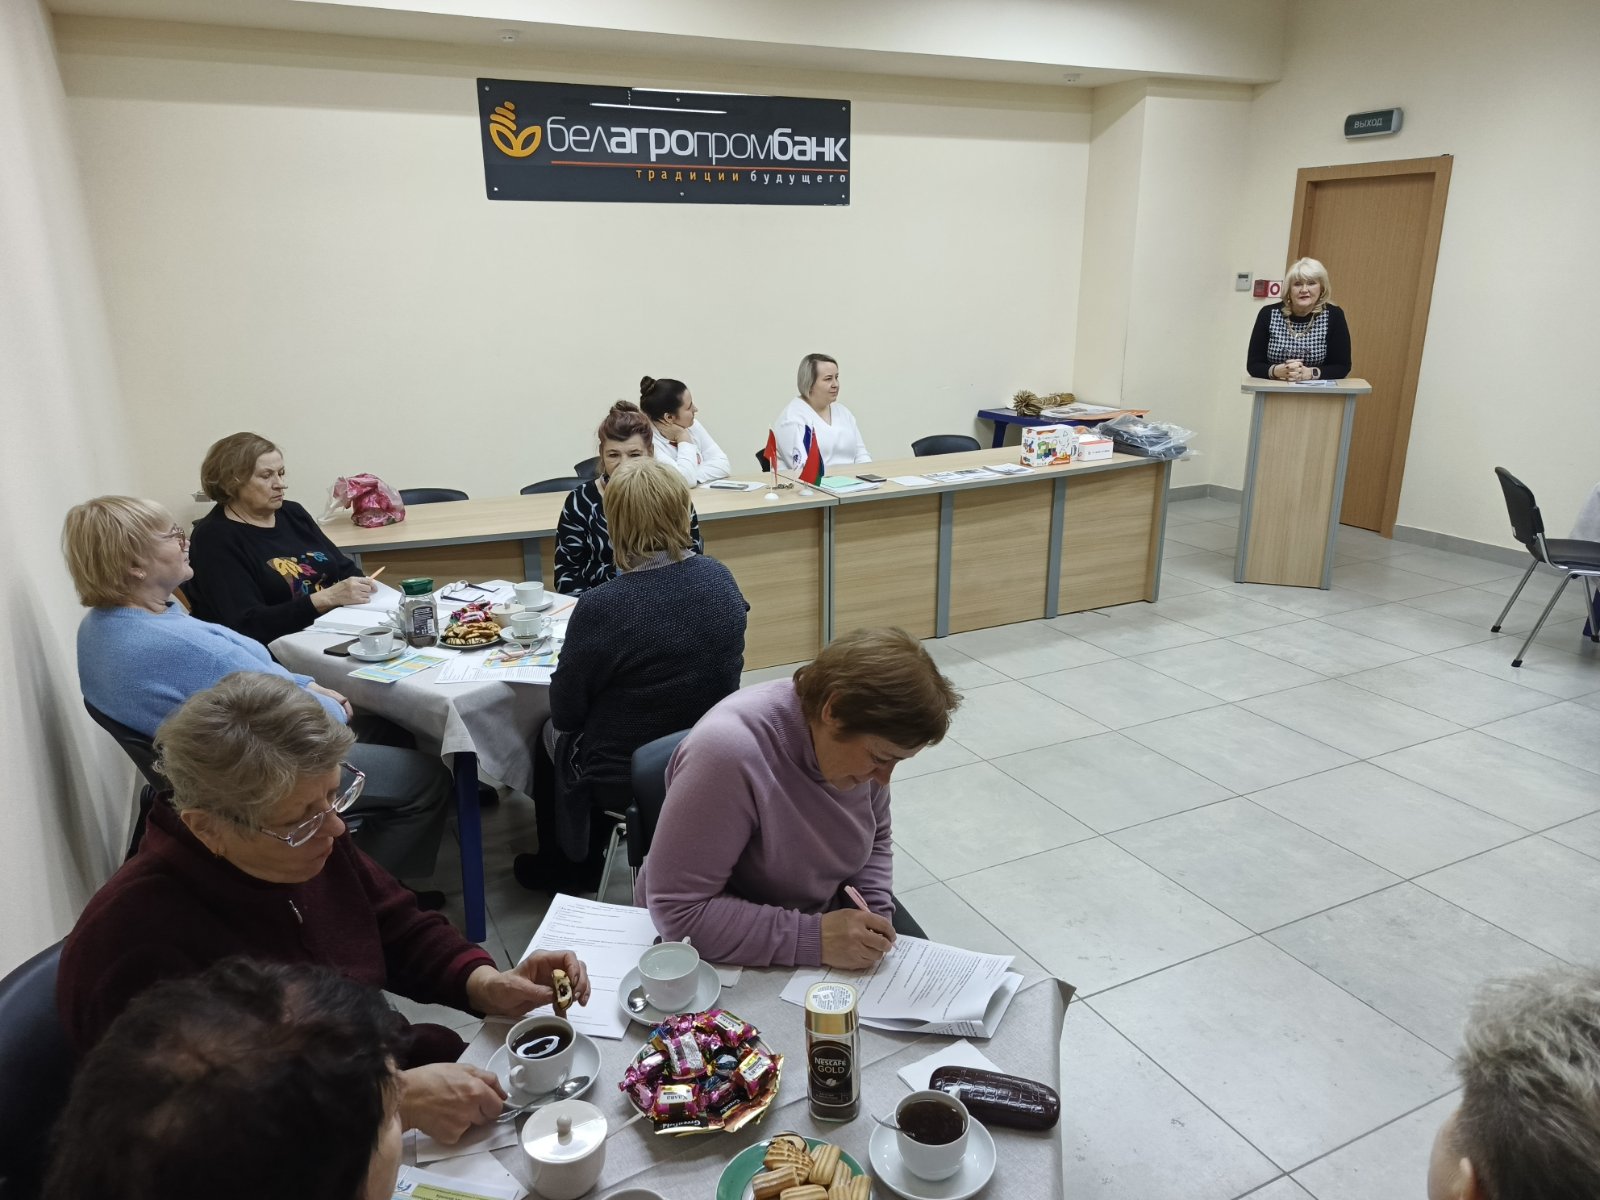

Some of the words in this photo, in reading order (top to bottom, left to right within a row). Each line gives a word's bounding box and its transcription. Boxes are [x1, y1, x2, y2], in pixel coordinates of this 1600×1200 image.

[1354, 118, 1383, 129] ВЫХОД
[635, 168, 740, 182] традиции
[750, 170, 847, 185] будущего
[817, 1065, 845, 1074] GOLD
